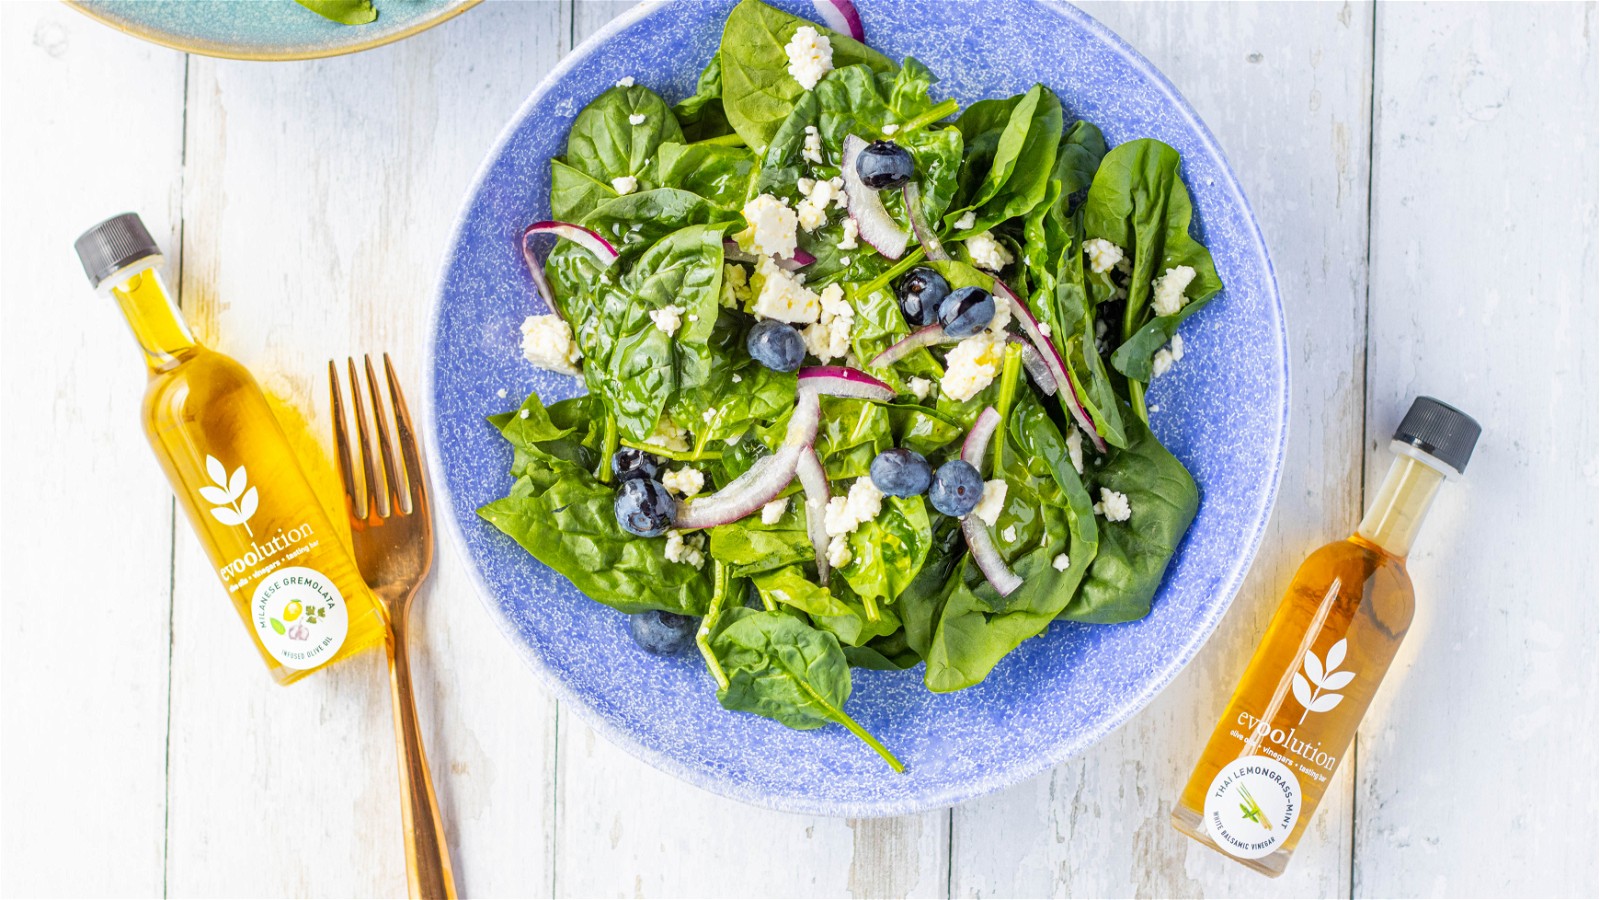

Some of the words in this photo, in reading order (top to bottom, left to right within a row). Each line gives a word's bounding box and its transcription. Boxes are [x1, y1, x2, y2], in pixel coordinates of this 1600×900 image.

[220, 523, 314, 582] evoolution
[252, 560, 281, 579] vinegars
[285, 545, 310, 560] tasting
[308, 540, 319, 549] bar
[258, 581, 281, 628] MILANESE
[283, 576, 336, 610] GREMOLATA
[281, 649, 305, 660] INFUSED
[306, 644, 324, 658] OLIVE
[322, 636, 333, 647] OIL
[1230, 729, 1244, 741] olive
[1263, 745, 1294, 766] vinegars
[1299, 764, 1319, 781] tasting
[1237, 711, 1336, 772] evoolution
[1215, 776, 1233, 798] THAI
[1213, 811, 1224, 831] WHITE
[1220, 829, 1250, 850] BALSAMIC
[1251, 836, 1276, 850] VINEGAR
